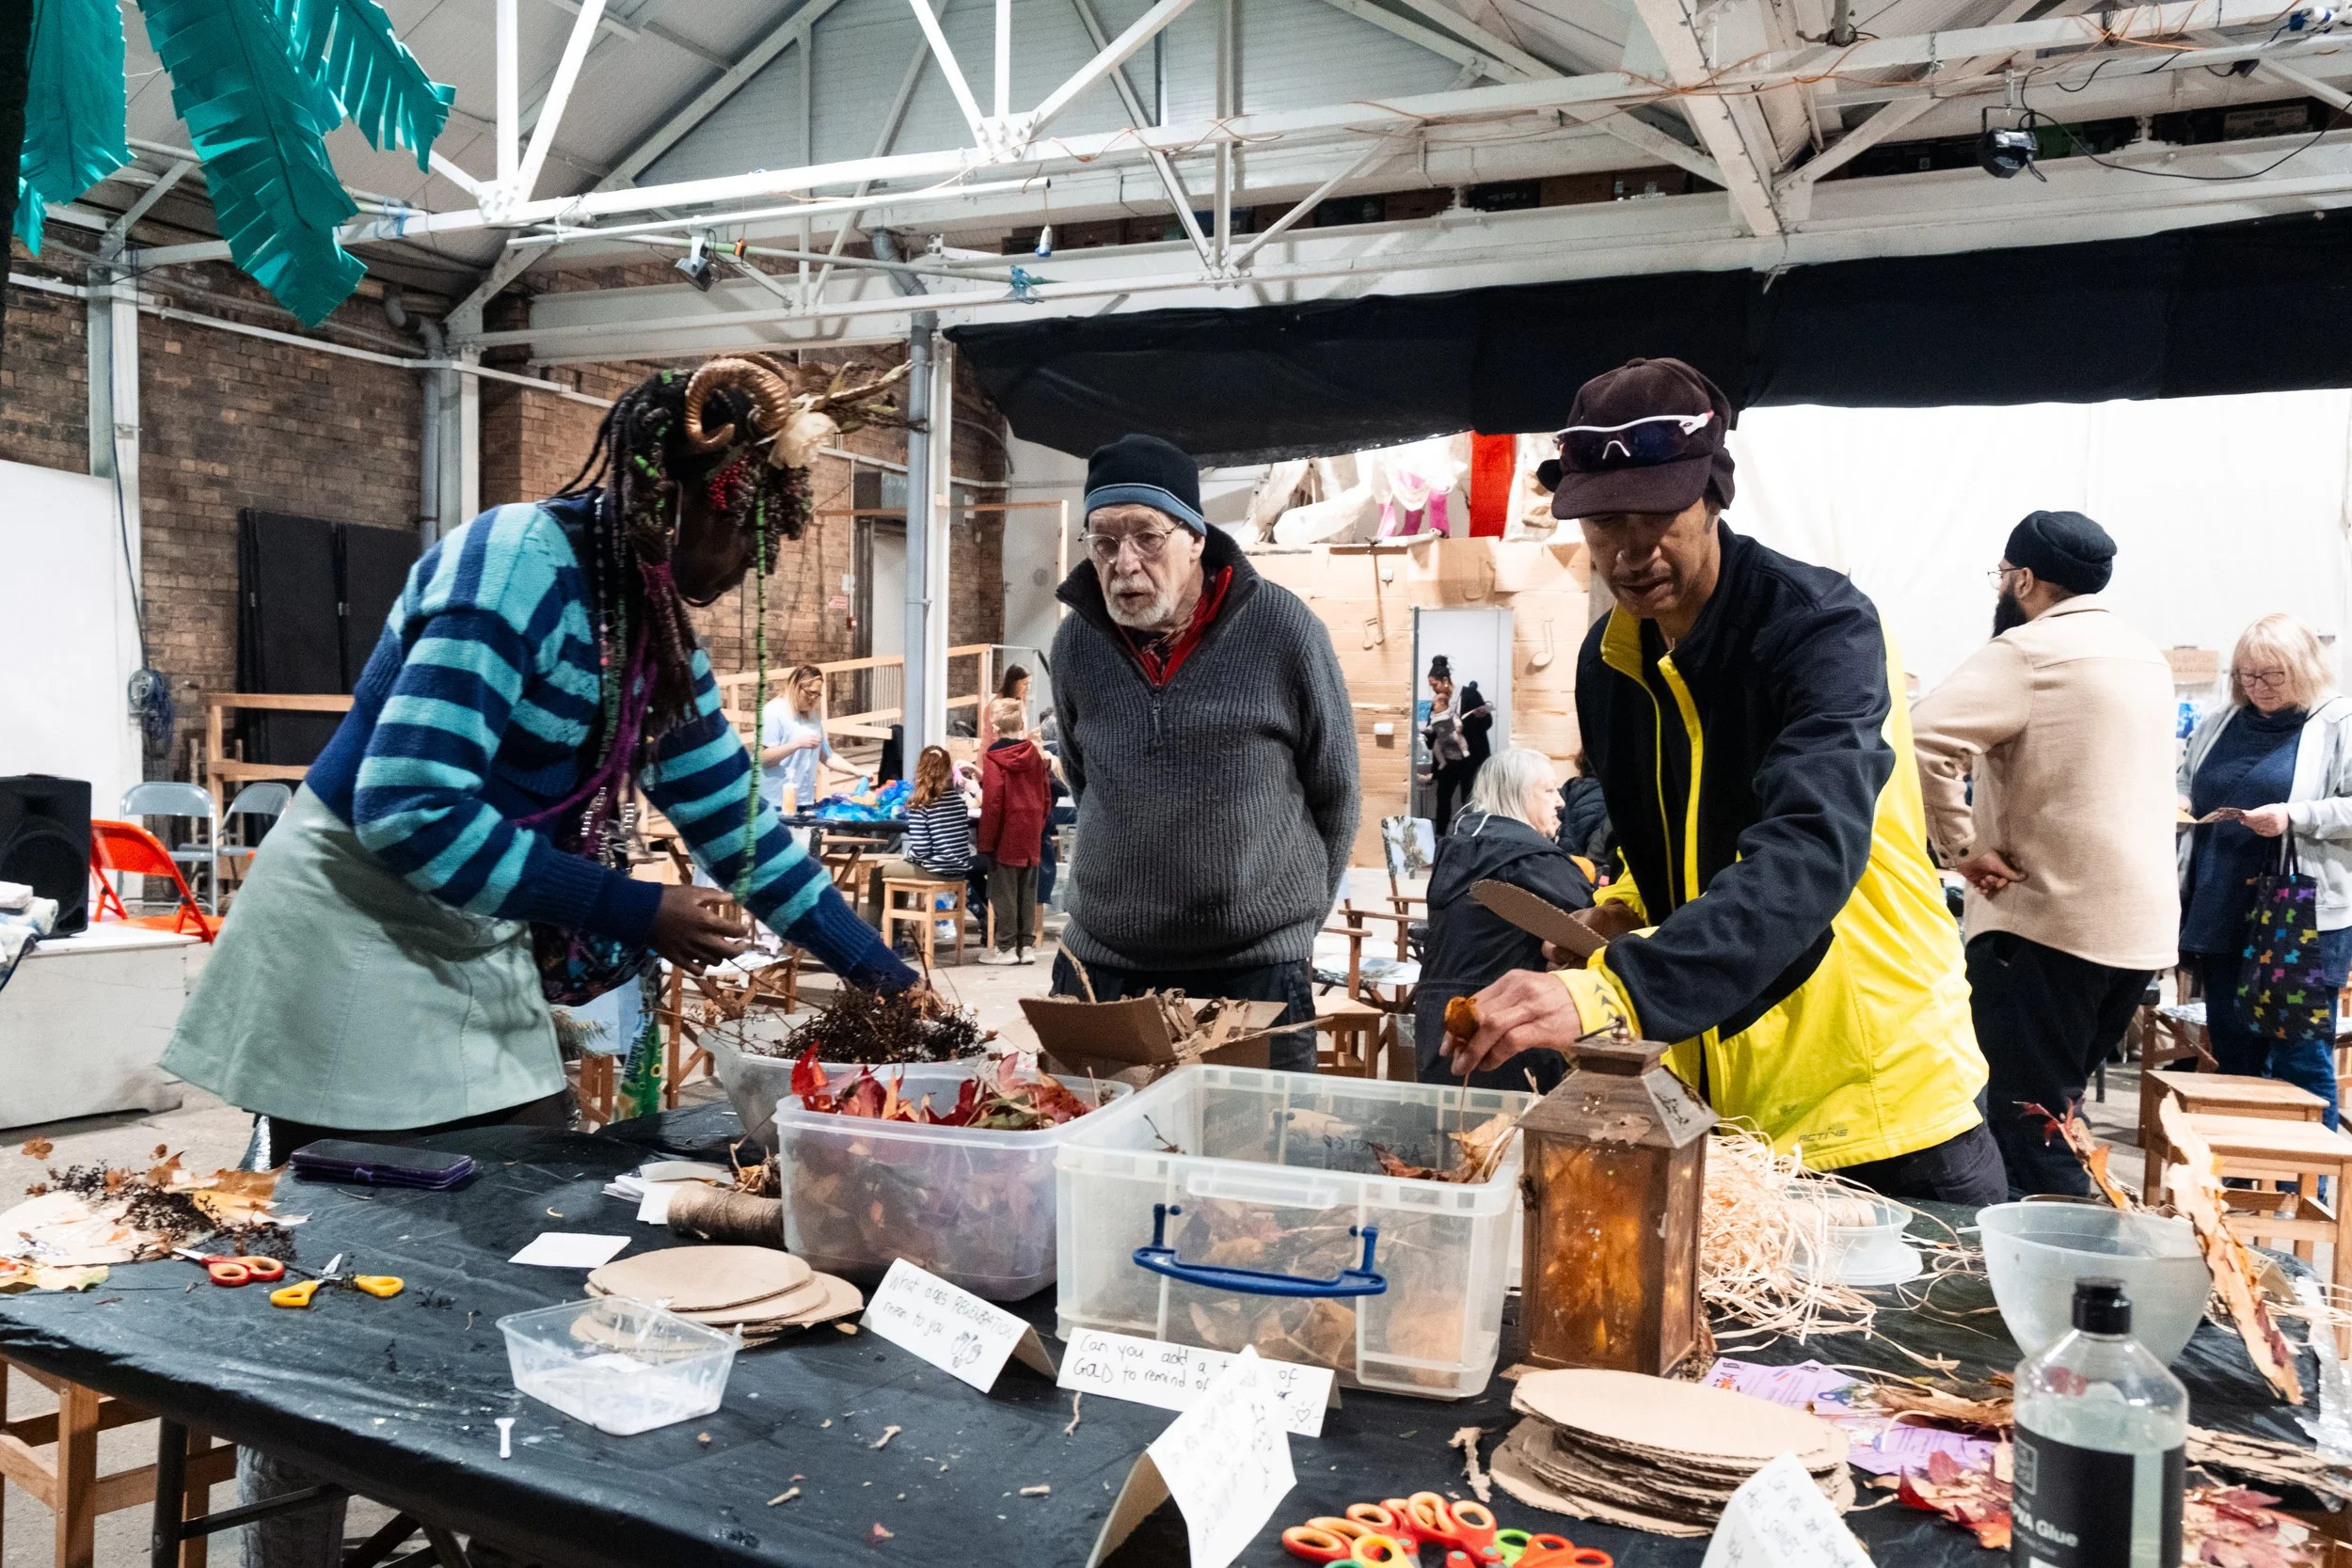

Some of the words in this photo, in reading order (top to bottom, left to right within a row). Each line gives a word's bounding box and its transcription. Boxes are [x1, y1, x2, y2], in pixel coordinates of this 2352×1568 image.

[887, 1270, 919, 1292] What
[924, 1281, 948, 1306] does
[912, 1309, 926, 1327] to
[923, 1319, 946, 1337] you
[1079, 1334, 1108, 1354] Can
[1117, 1344, 1145, 1362] you
[1161, 1346, 1188, 1365] add
[1198, 1361, 1207, 1374] a
[1278, 1367, 1298, 1387] of
[1121, 1368, 1136, 1384] to
[1144, 1370, 1186, 1388] remind
[2035, 1518, 2079, 1548] Glue
